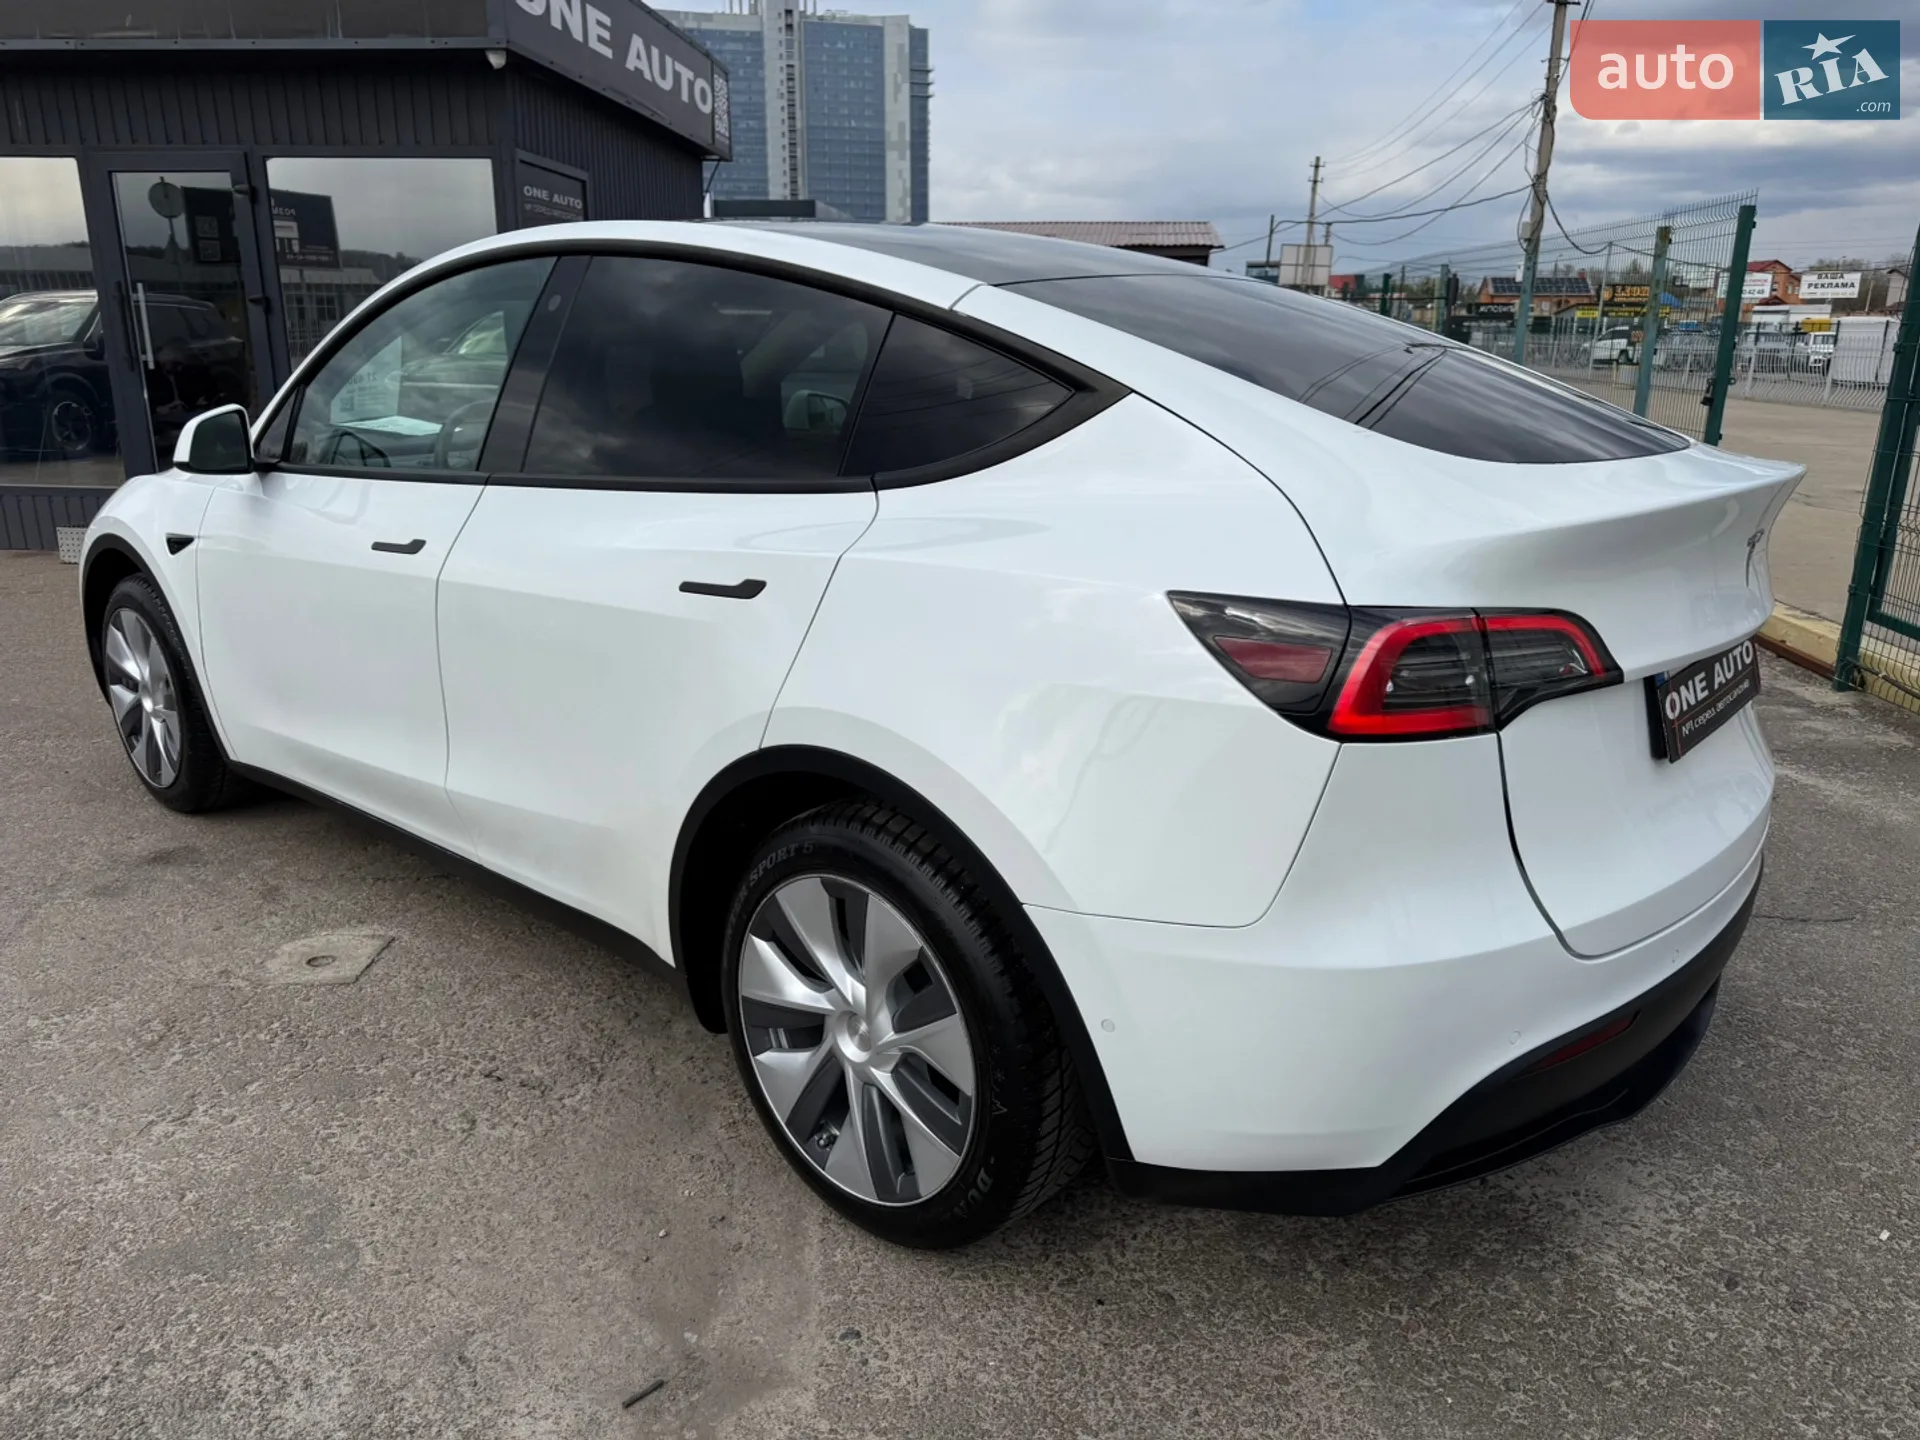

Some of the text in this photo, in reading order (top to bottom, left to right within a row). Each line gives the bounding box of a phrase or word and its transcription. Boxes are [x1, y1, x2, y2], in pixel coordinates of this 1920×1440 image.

[625, 34, 713, 114] AUTO
[523, 185, 583, 209] ONE AUTO
[1665, 639, 1754, 720] ONE AUTO
[749, 843, 799, 887] SPORT
[802, 841, 815, 855] 5
